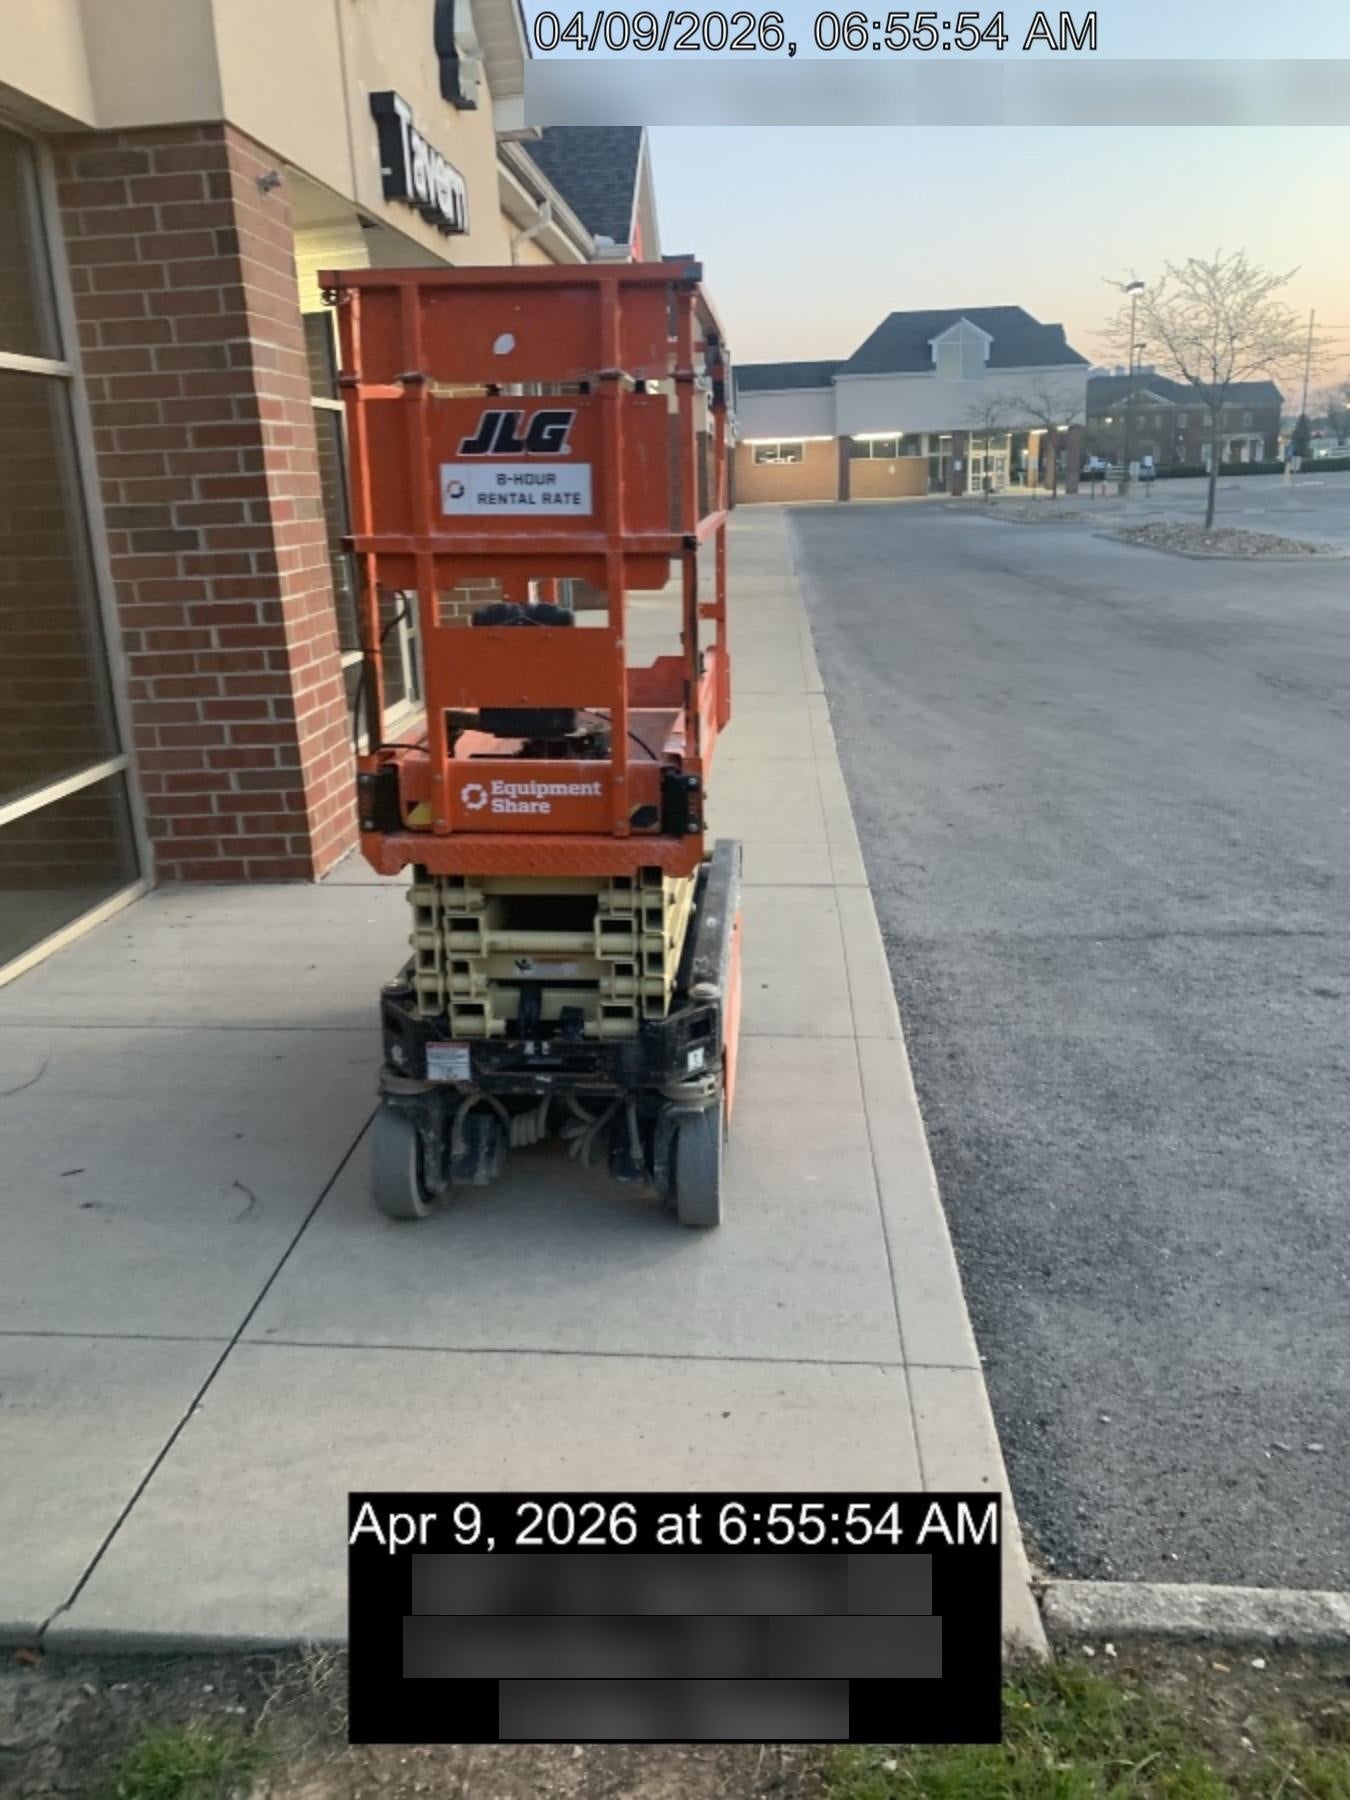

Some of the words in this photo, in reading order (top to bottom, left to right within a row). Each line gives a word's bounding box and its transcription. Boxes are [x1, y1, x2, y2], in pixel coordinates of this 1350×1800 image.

[371, 90, 470, 236] Tavern
[456, 409, 577, 456] JLG
[495, 472, 557, 486] 8-HOUR
[477, 491, 537, 505] RENTAL
[541, 491, 582, 505] RATE
[490, 779, 602, 799] Equipment
[490, 797, 551, 814] Share
